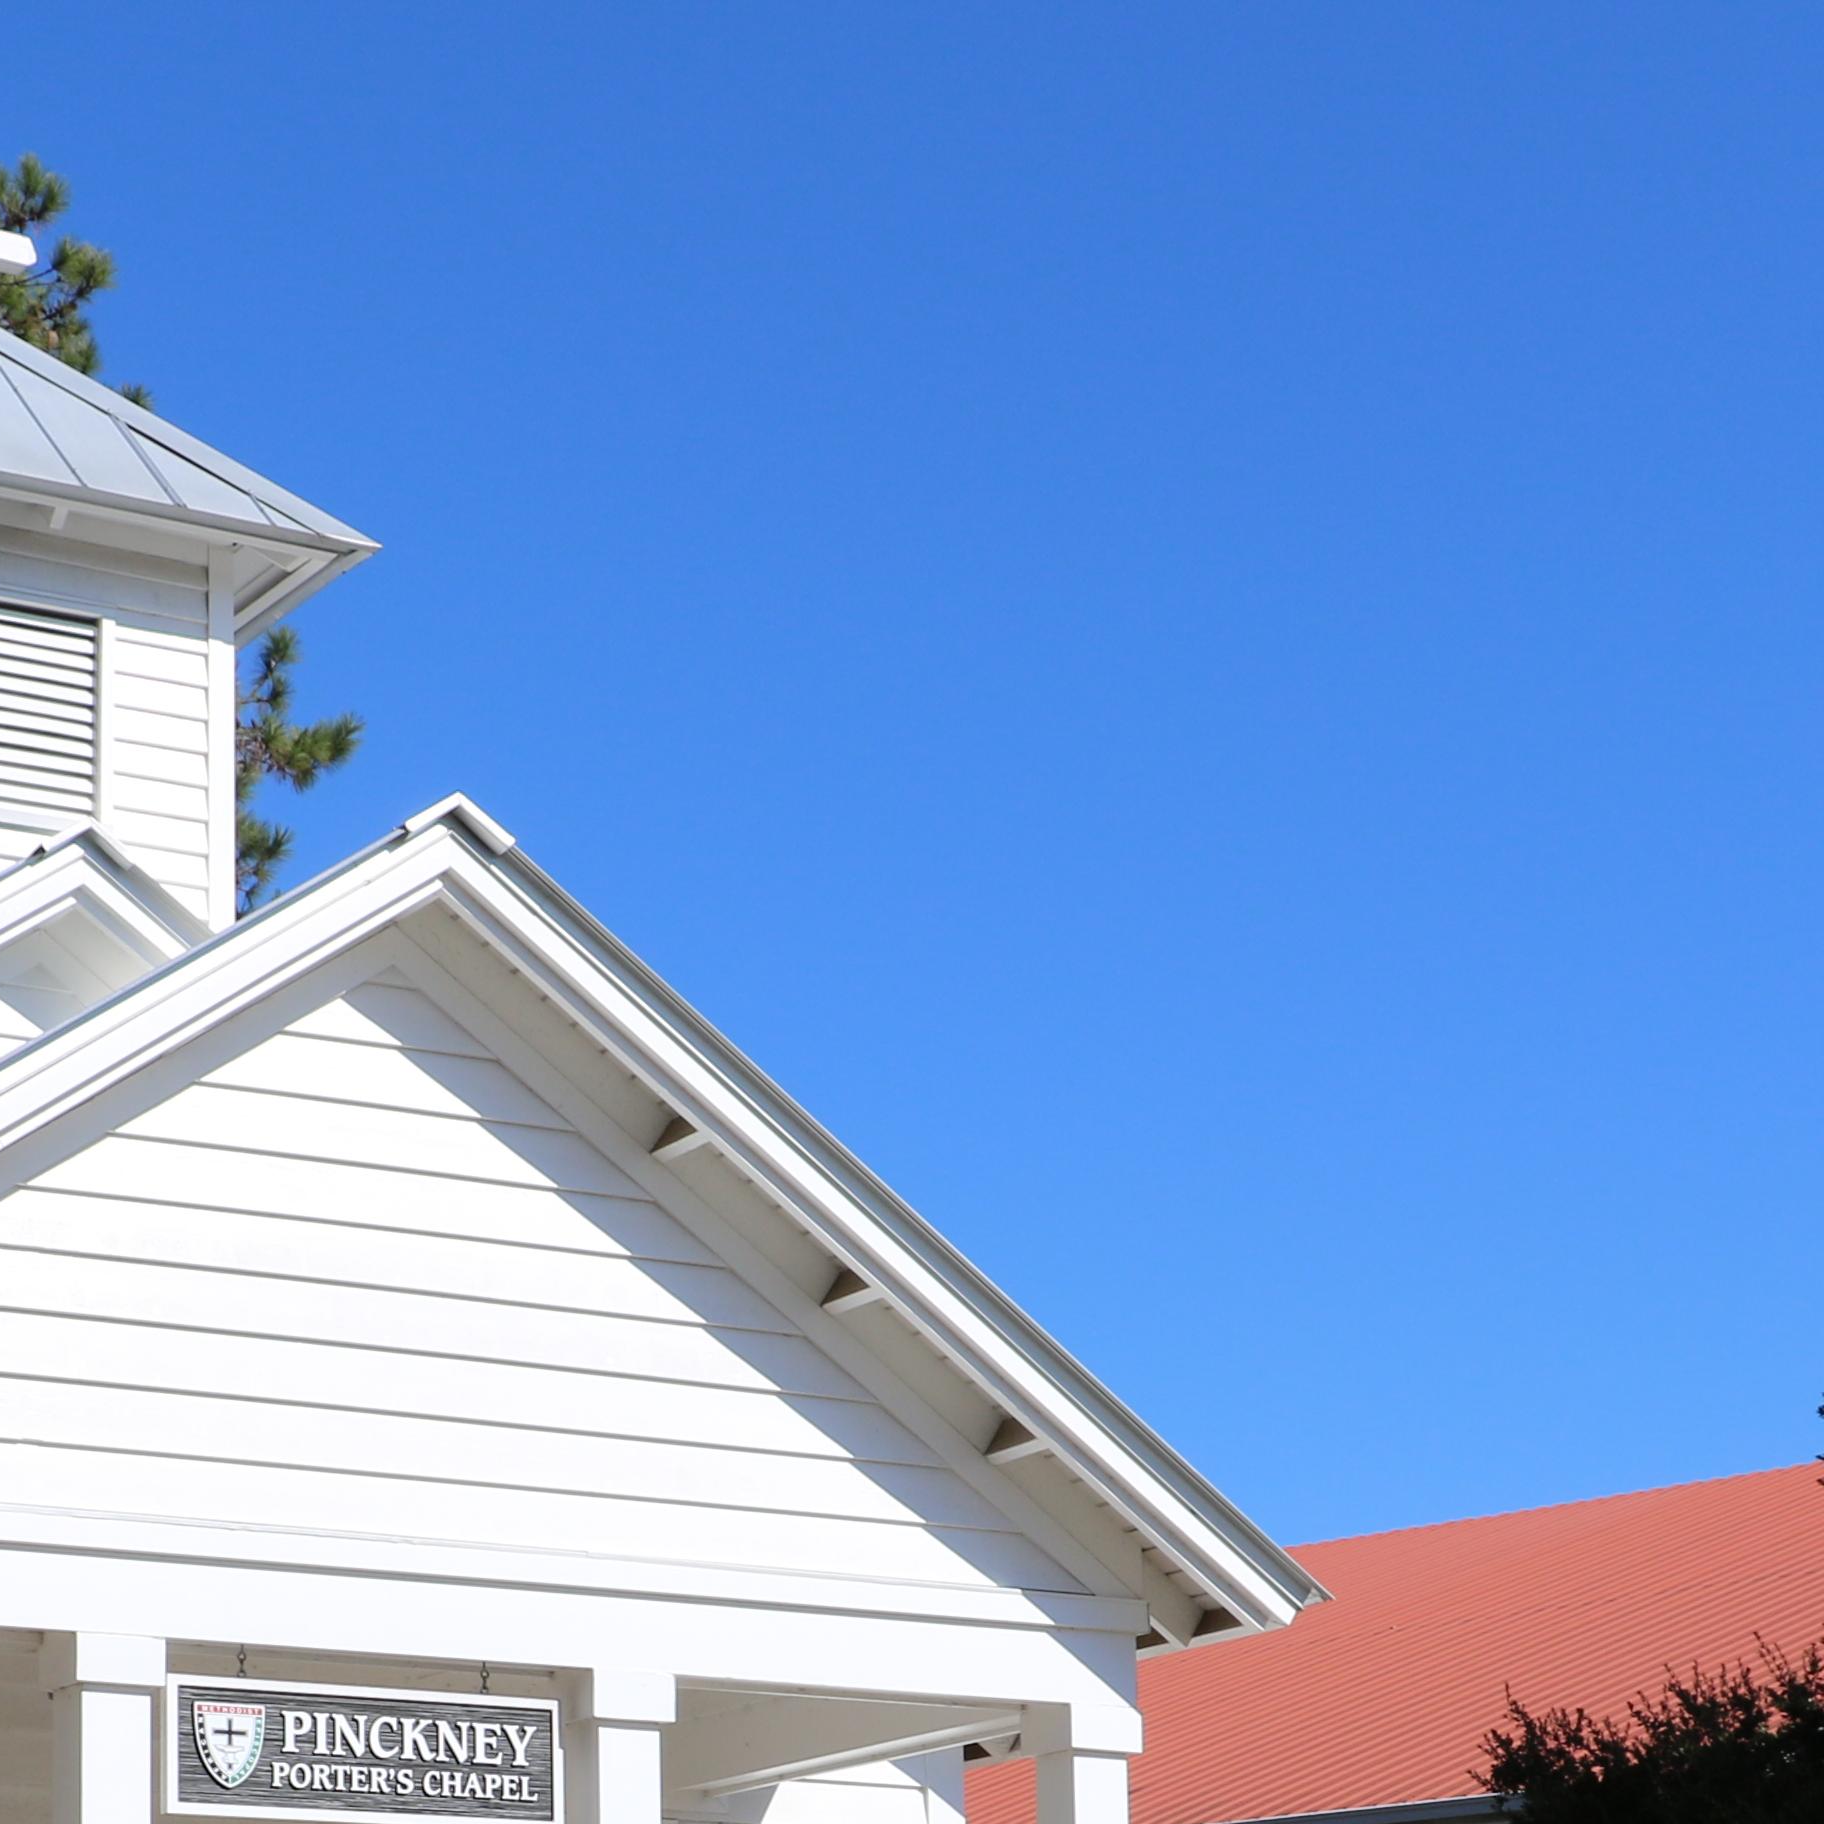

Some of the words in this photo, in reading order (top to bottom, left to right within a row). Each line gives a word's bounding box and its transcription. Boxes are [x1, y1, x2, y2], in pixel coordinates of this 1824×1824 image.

[201, 1705, 259, 1714] METHODIST
[280, 1709, 538, 1767] PINCKNEY
[270, 1761, 415, 1795] PORTER'S
[422, 1769, 538, 1802] CHAPEL
